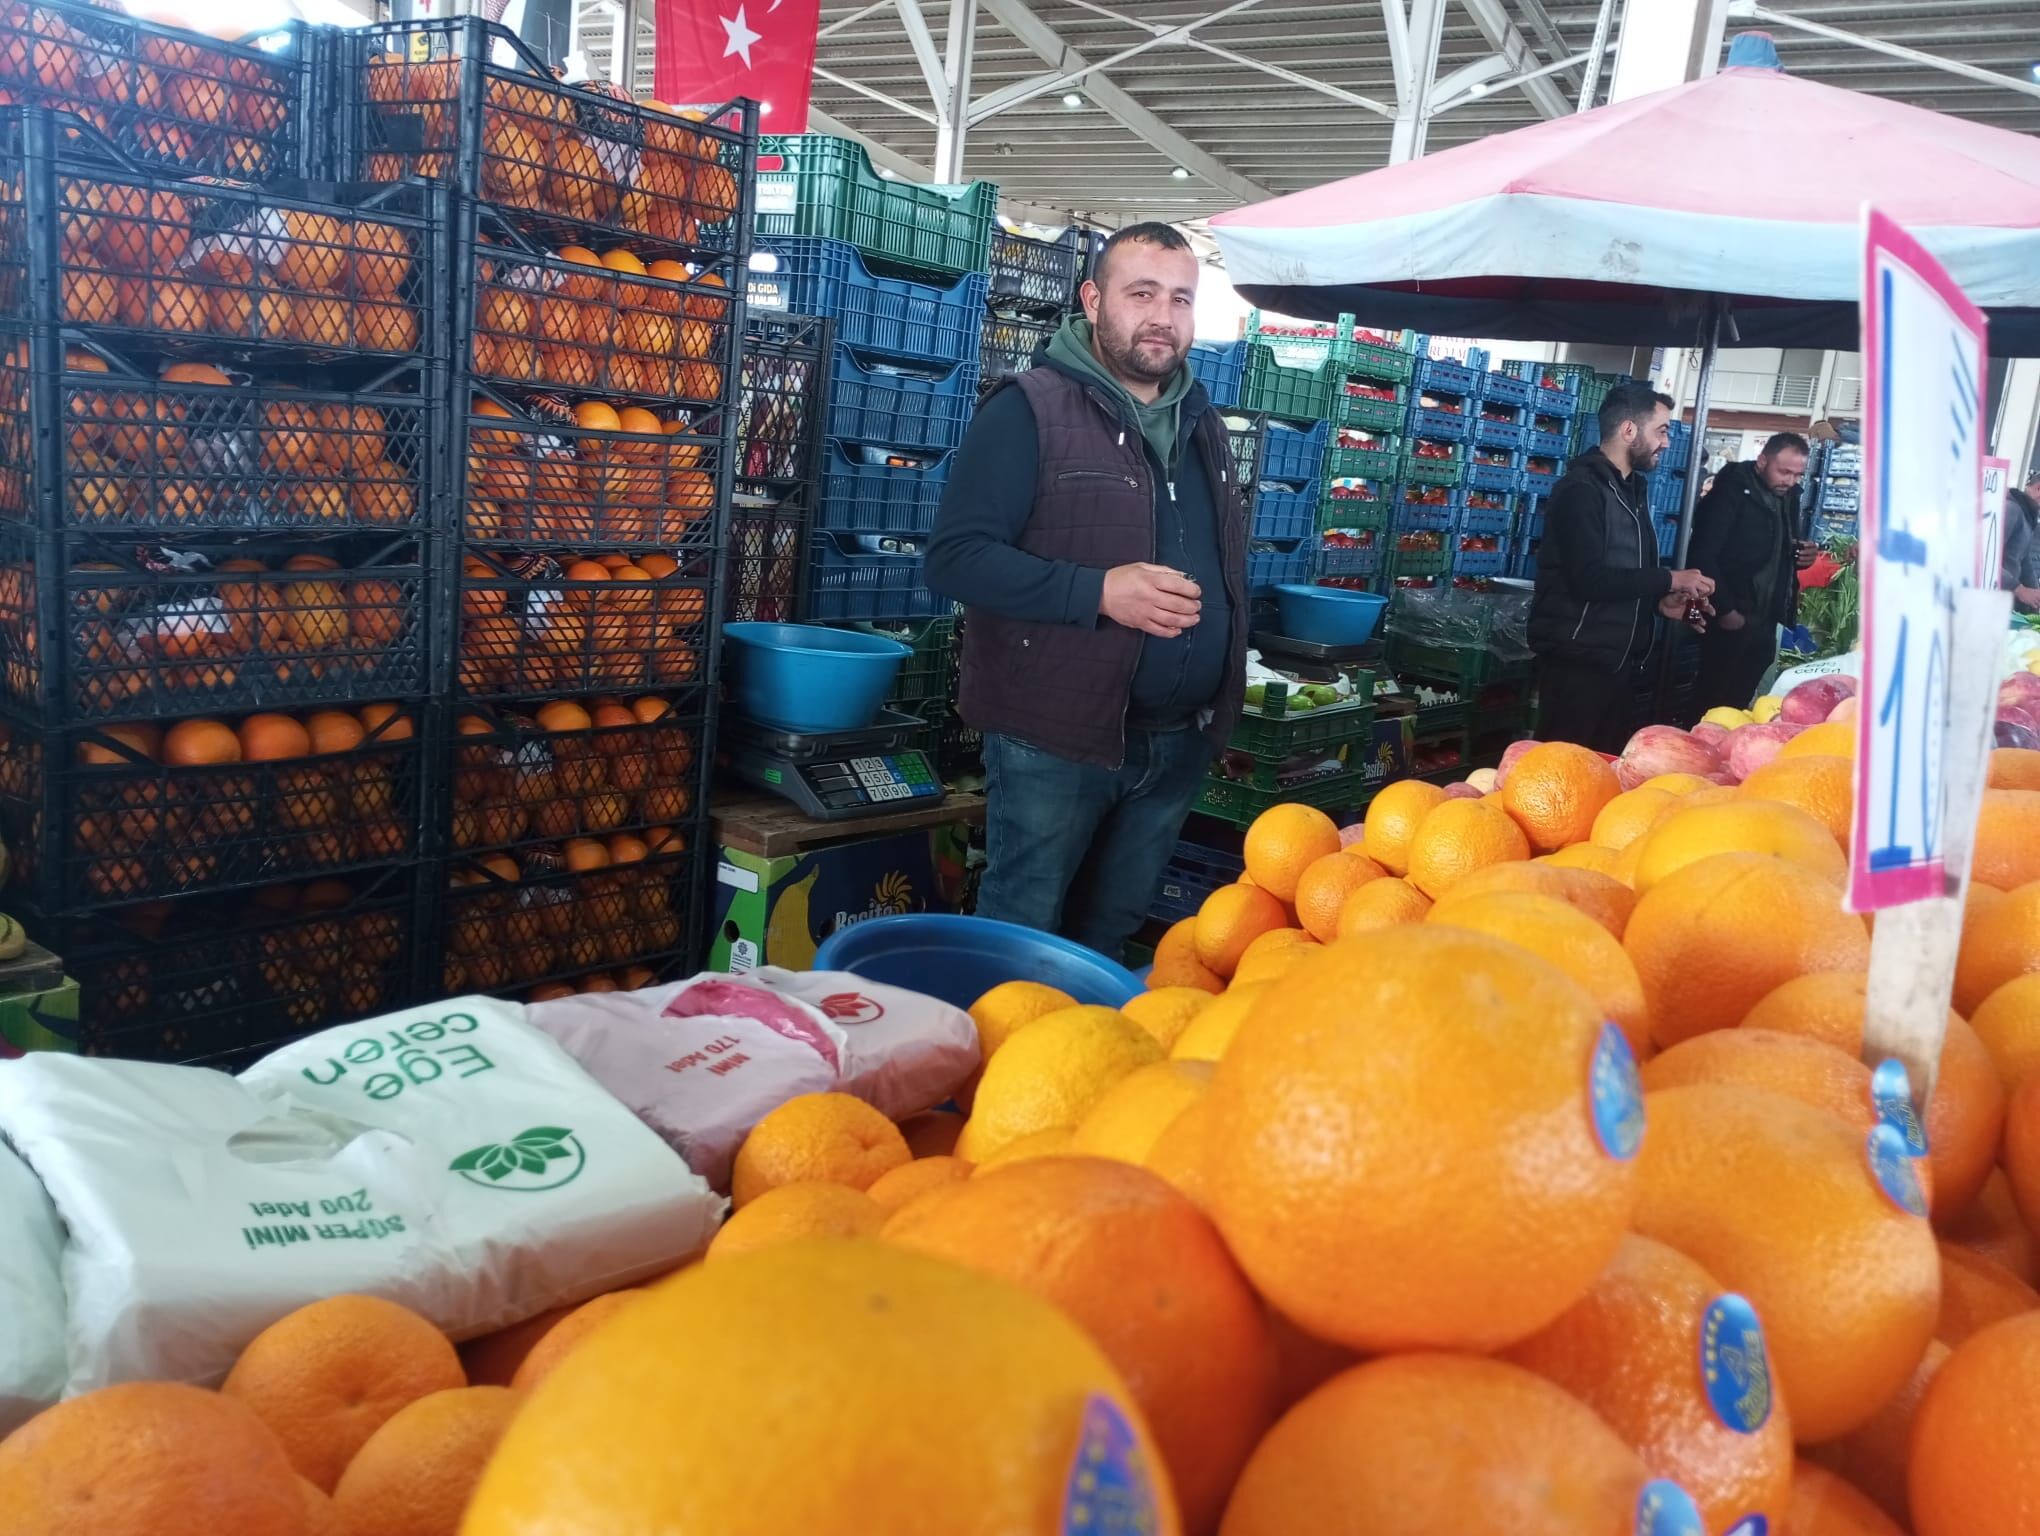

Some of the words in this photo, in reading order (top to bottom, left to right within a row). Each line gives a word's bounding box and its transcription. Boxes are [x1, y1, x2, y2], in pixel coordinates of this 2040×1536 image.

[758, 283, 778, 294] GIDA
[865, 761, 873, 769] 2
[876, 759, 884, 768] 3
[863, 775, 871, 784] 4
[874, 774, 881, 783] 5
[884, 773, 892, 782] 6
[870, 790, 878, 799] 7
[881, 788, 889, 797] 8
[892, 787, 900, 796] 9
[902, 786, 909, 795] 0
[301, 1012, 479, 1085] ceren
[704, 1035, 741, 1054] 170
[364, 1044, 496, 1100] Ege
[248, 1200, 311, 1218] Adet
[319, 1188, 373, 1215] 200
